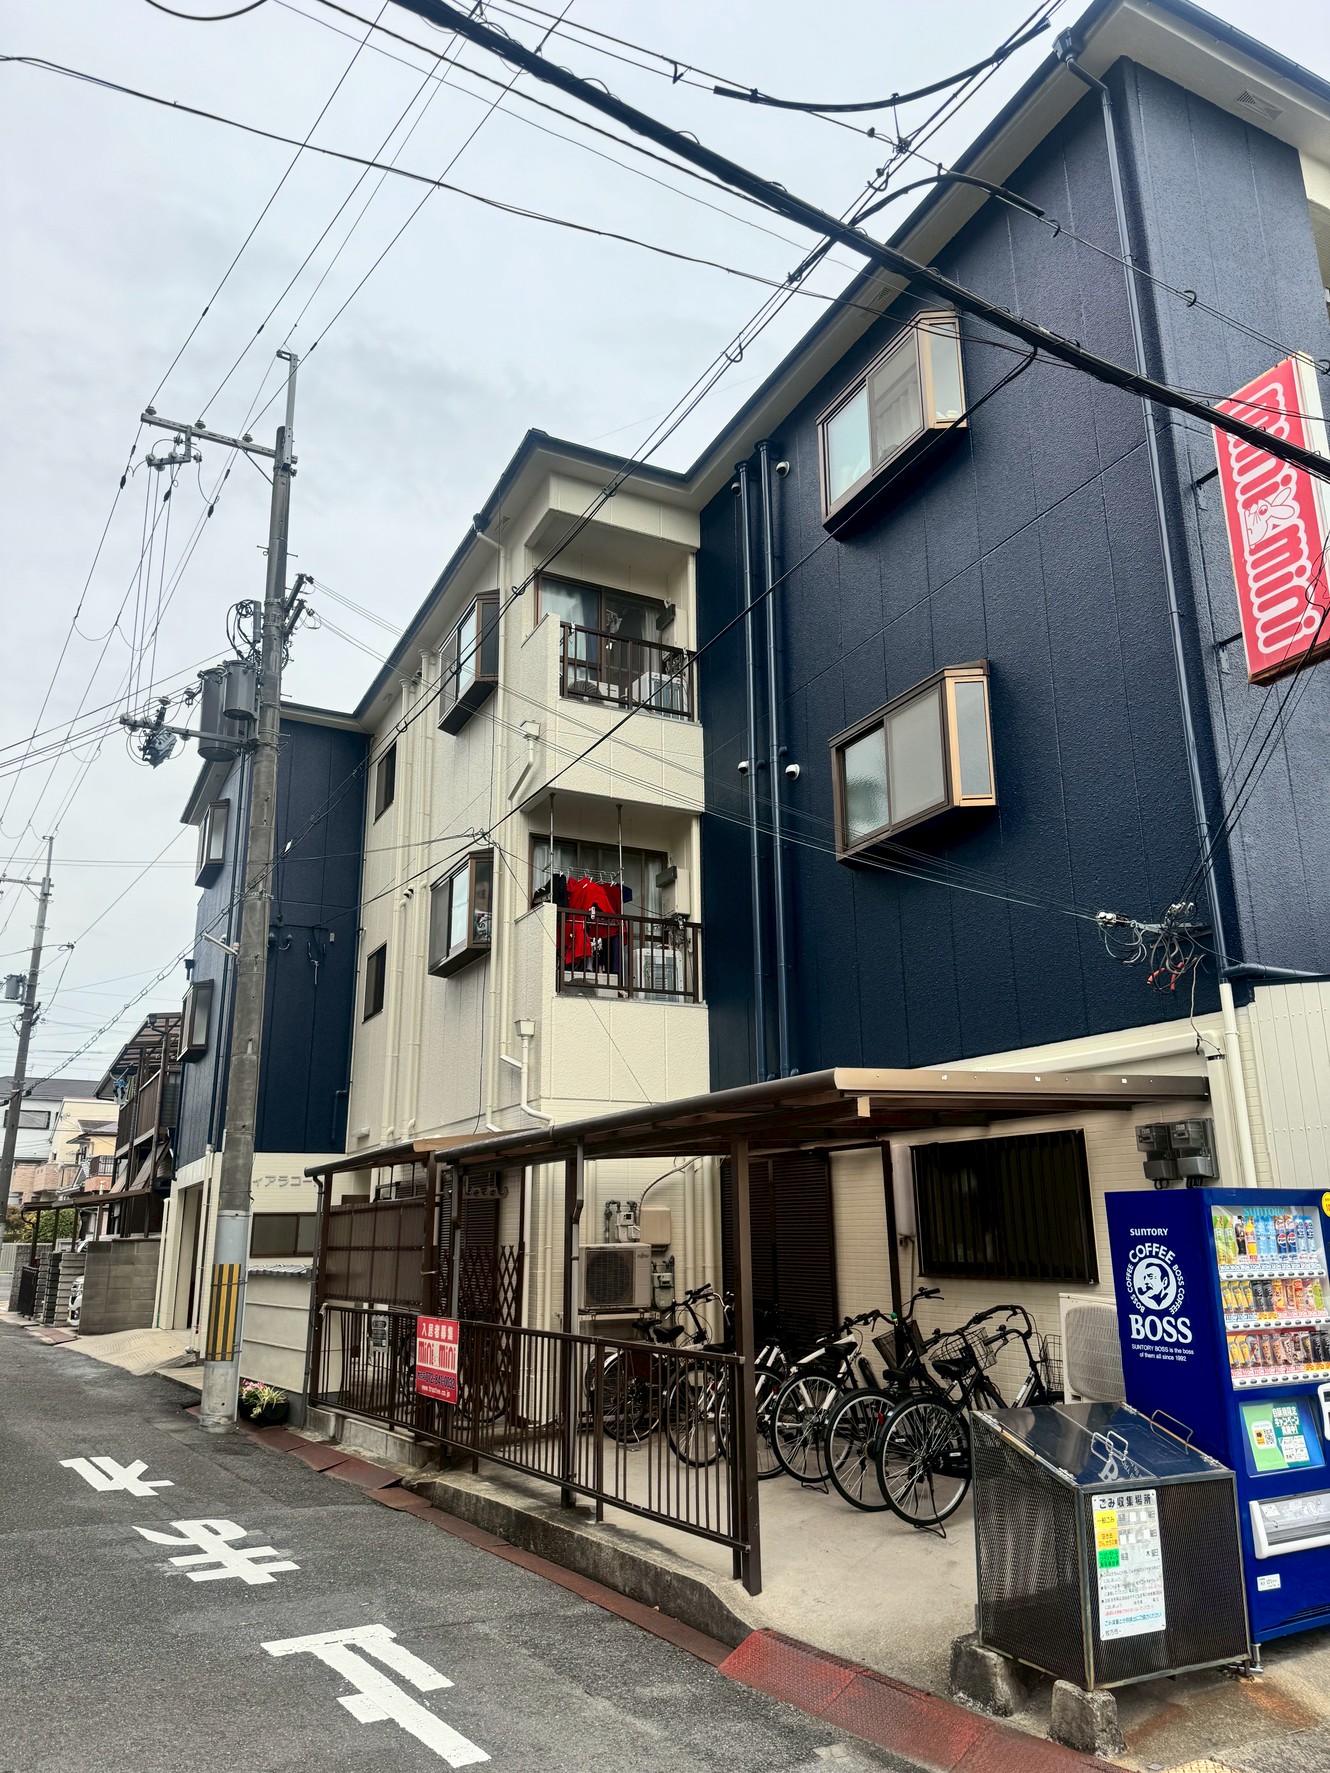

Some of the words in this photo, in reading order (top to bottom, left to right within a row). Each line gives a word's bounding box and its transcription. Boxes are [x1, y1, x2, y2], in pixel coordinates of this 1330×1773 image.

[1245, 518, 1321, 654] mini
[1129, 1228, 1169, 1236] SUNTORY
[1128, 1242, 1176, 1265] COFFEE
[1126, 1262, 1135, 1294] COFFEE
[1172, 1263, 1185, 1287] BOSS
[1130, 1293, 1146, 1314] BOSS
[1168, 1286, 1186, 1316] COFFEE
[421, 1322, 454, 1341] 入居者募集
[1128, 1314, 1193, 1344] BOSS
[1131, 1344, 1154, 1352] SUNTORY
[1099, 1493, 1151, 1509] ごみ収集場所
